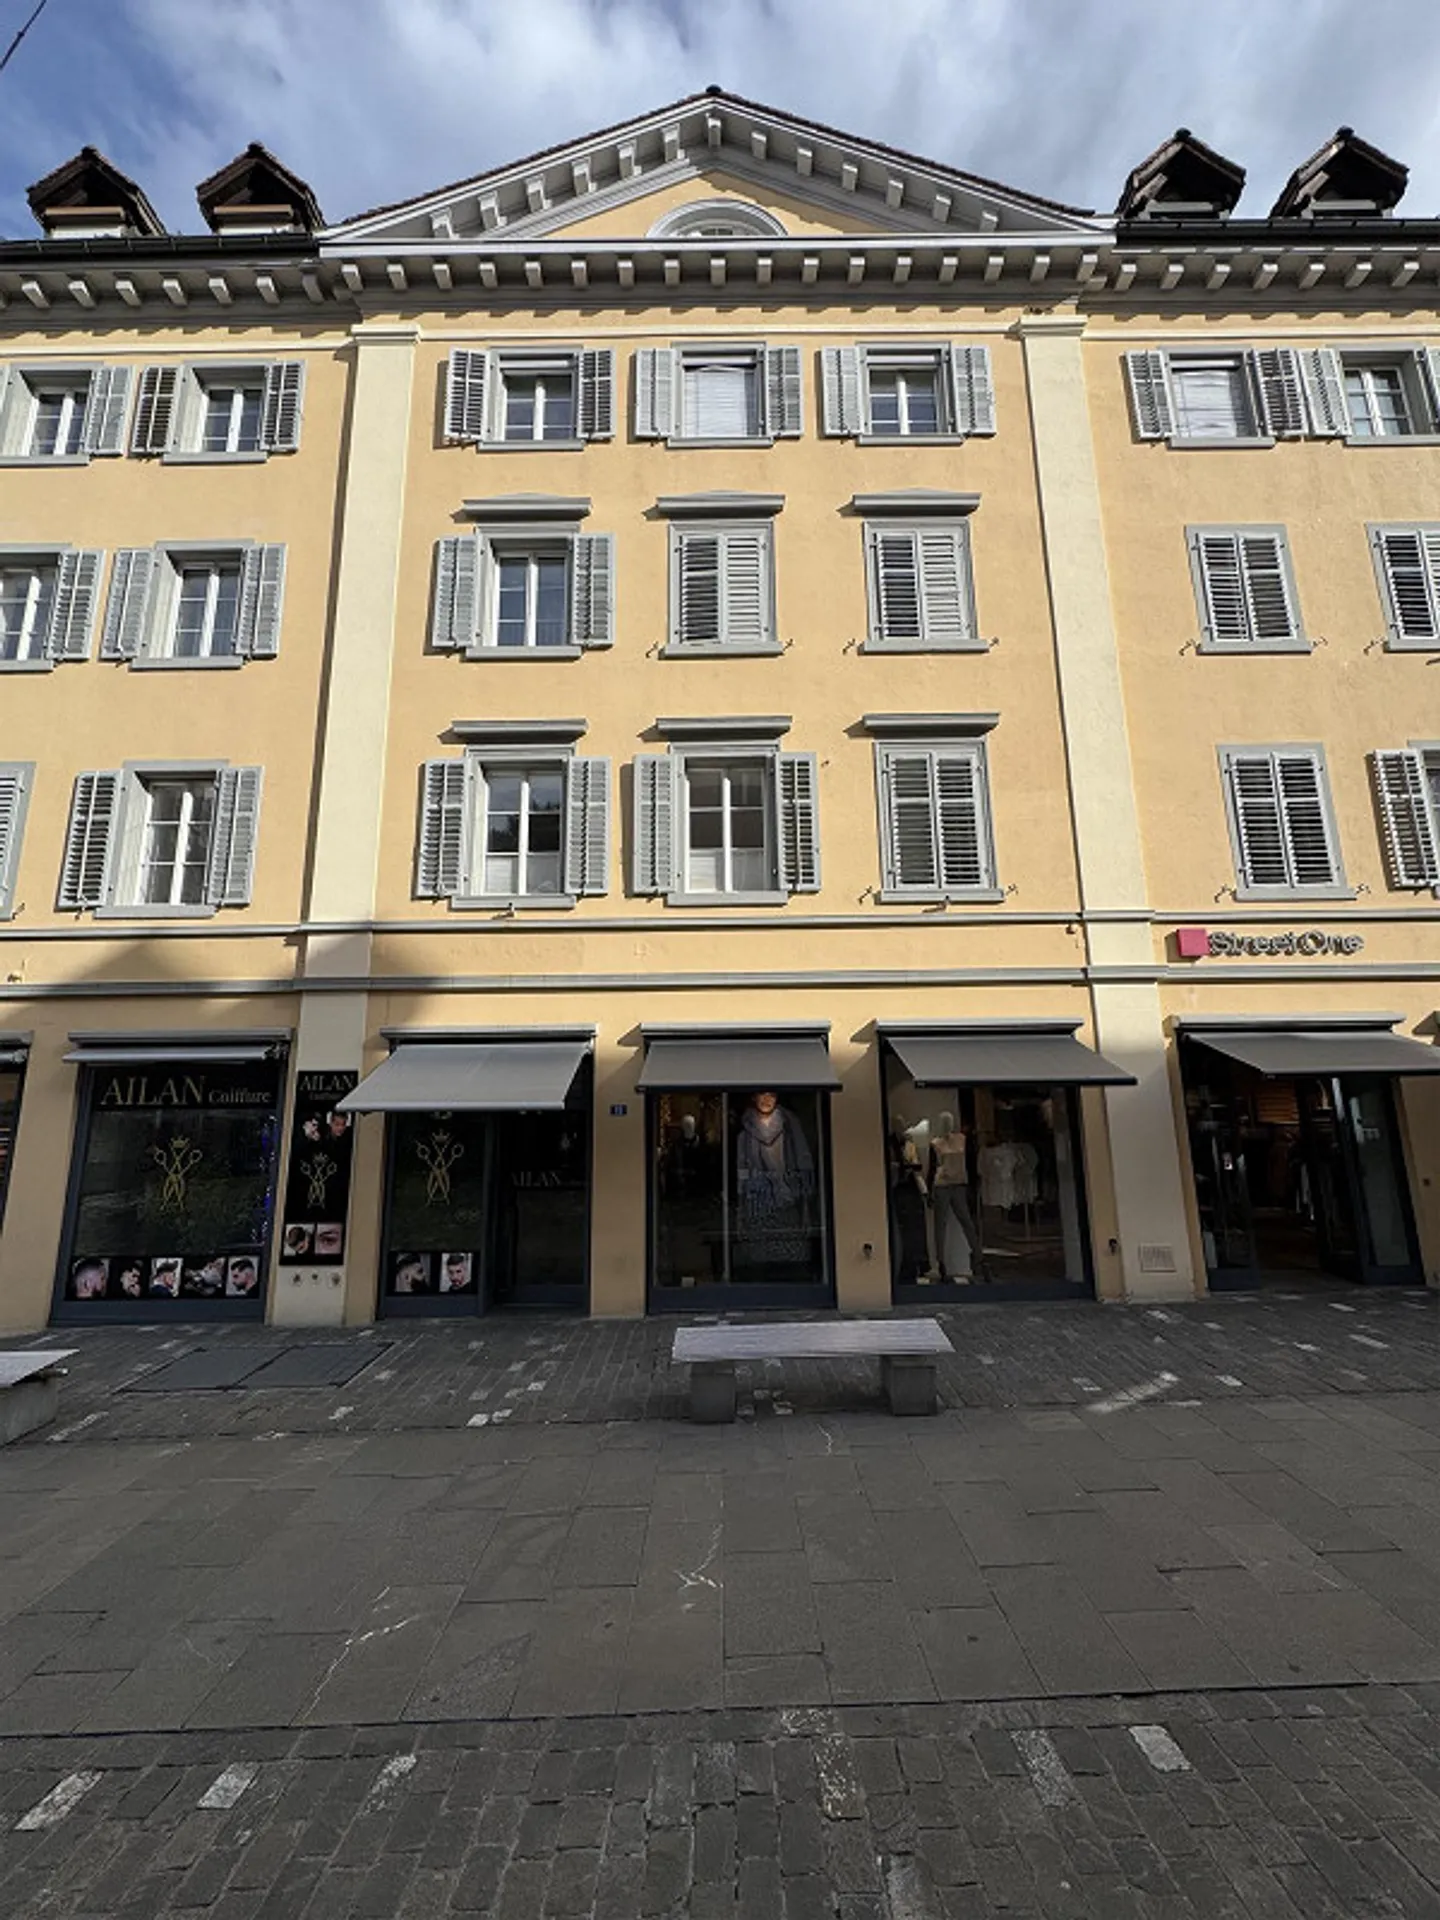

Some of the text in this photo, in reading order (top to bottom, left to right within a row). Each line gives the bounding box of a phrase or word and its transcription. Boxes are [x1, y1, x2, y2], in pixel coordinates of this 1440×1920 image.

[100, 1074, 272, 1106] AILAN Coiffure
[299, 1074, 355, 1091] AILAN
